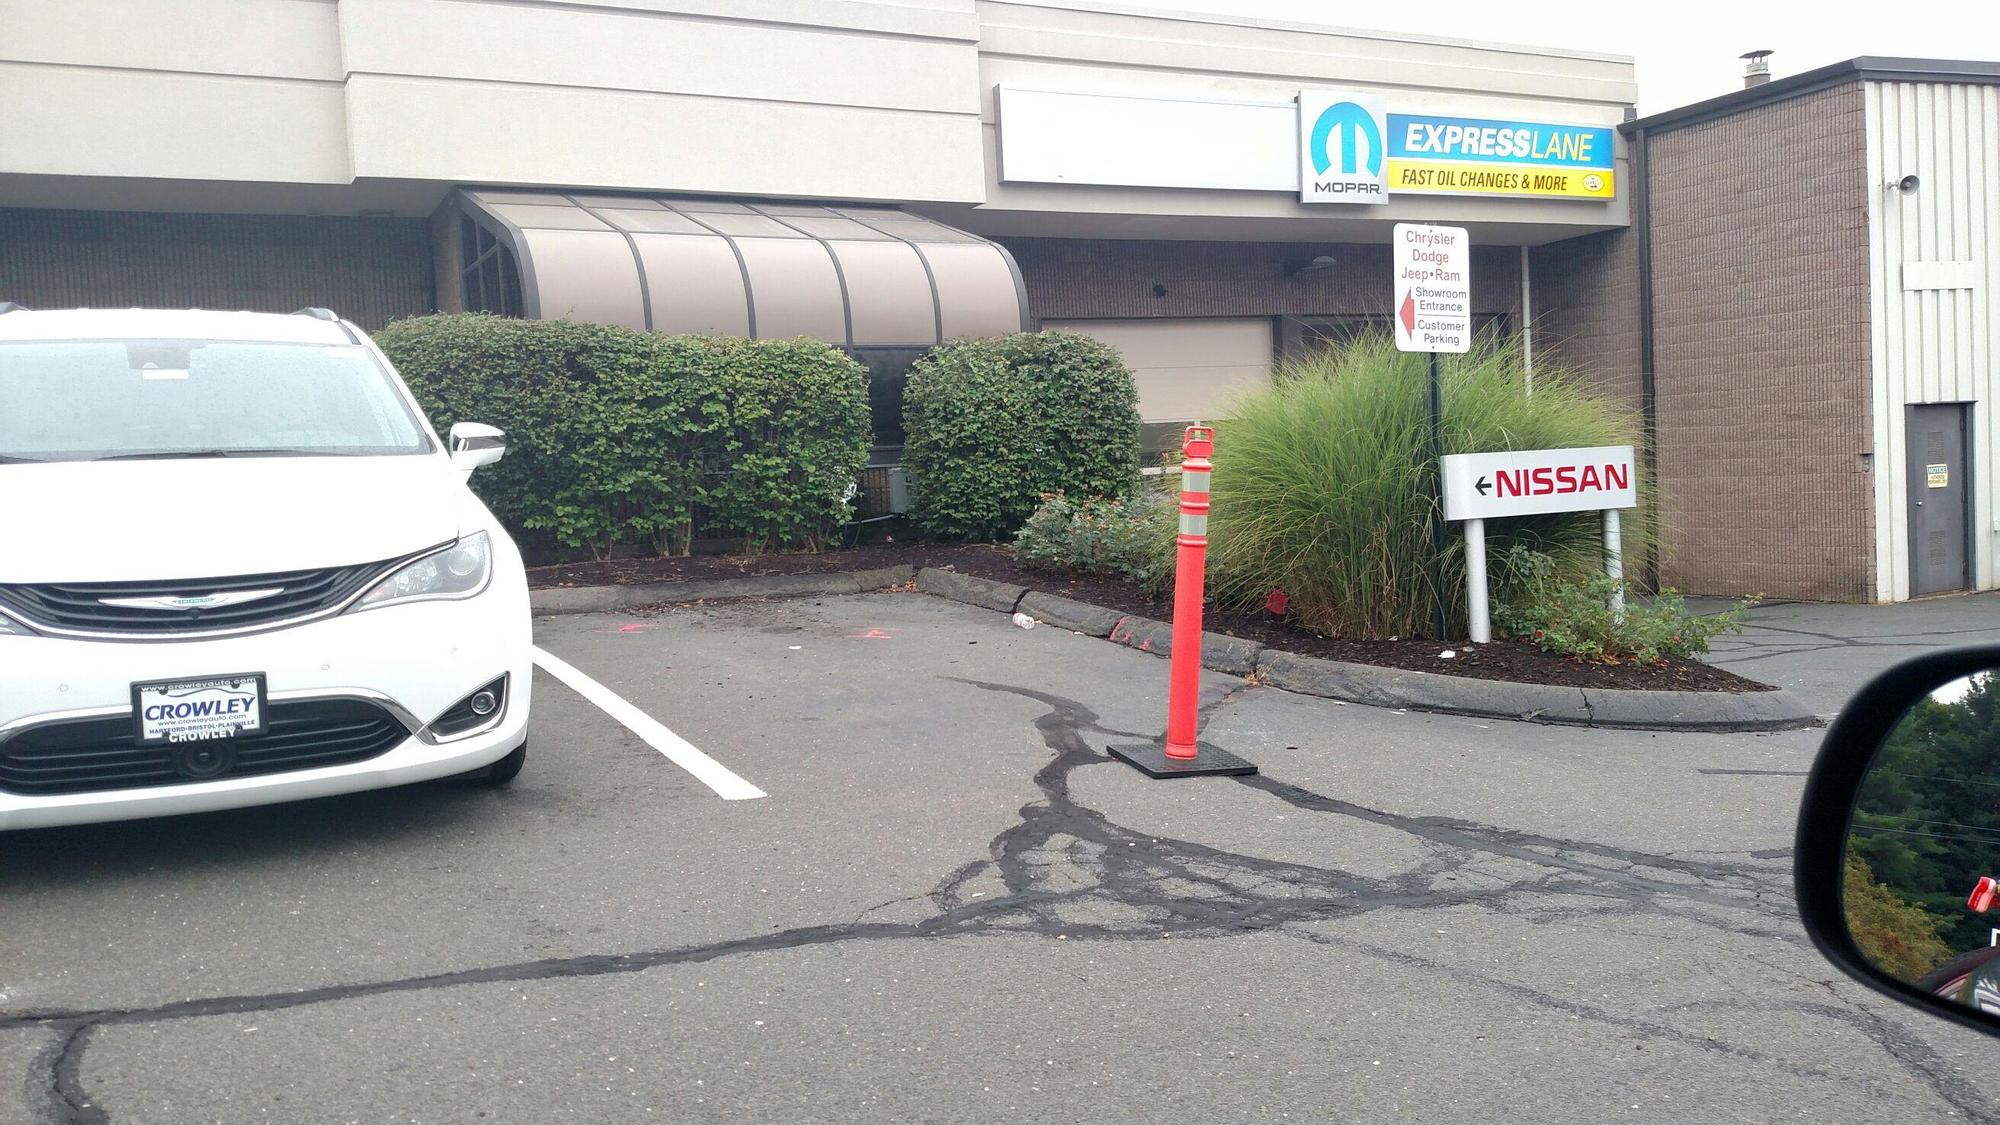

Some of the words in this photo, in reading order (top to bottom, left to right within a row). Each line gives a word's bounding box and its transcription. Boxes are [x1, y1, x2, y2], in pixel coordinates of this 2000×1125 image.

[1402, 169, 1434, 185] FAST
[1437, 170, 1456, 186] OIL
[1460, 171, 1518, 189] CHANGES
[1521, 175, 1530, 189] &
[1534, 175, 1568, 191] MORE
[1315, 182, 1379, 194] MOPAR
[1406, 230, 1455, 247] Chrysler
[1413, 249, 1449, 265] Dodge
[1415, 287, 1467, 299] Showroom
[1420, 300, 1463, 312] Entrance
[1418, 320, 1465, 331] Customer
[1424, 333, 1460, 346] Parking
[1496, 463, 1628, 498] NISSAN
[141, 678, 256, 692] www.crowleyauto.com
[145, 697, 256, 721] CROWLEY
[169, 729, 236, 743] CROWLEY
